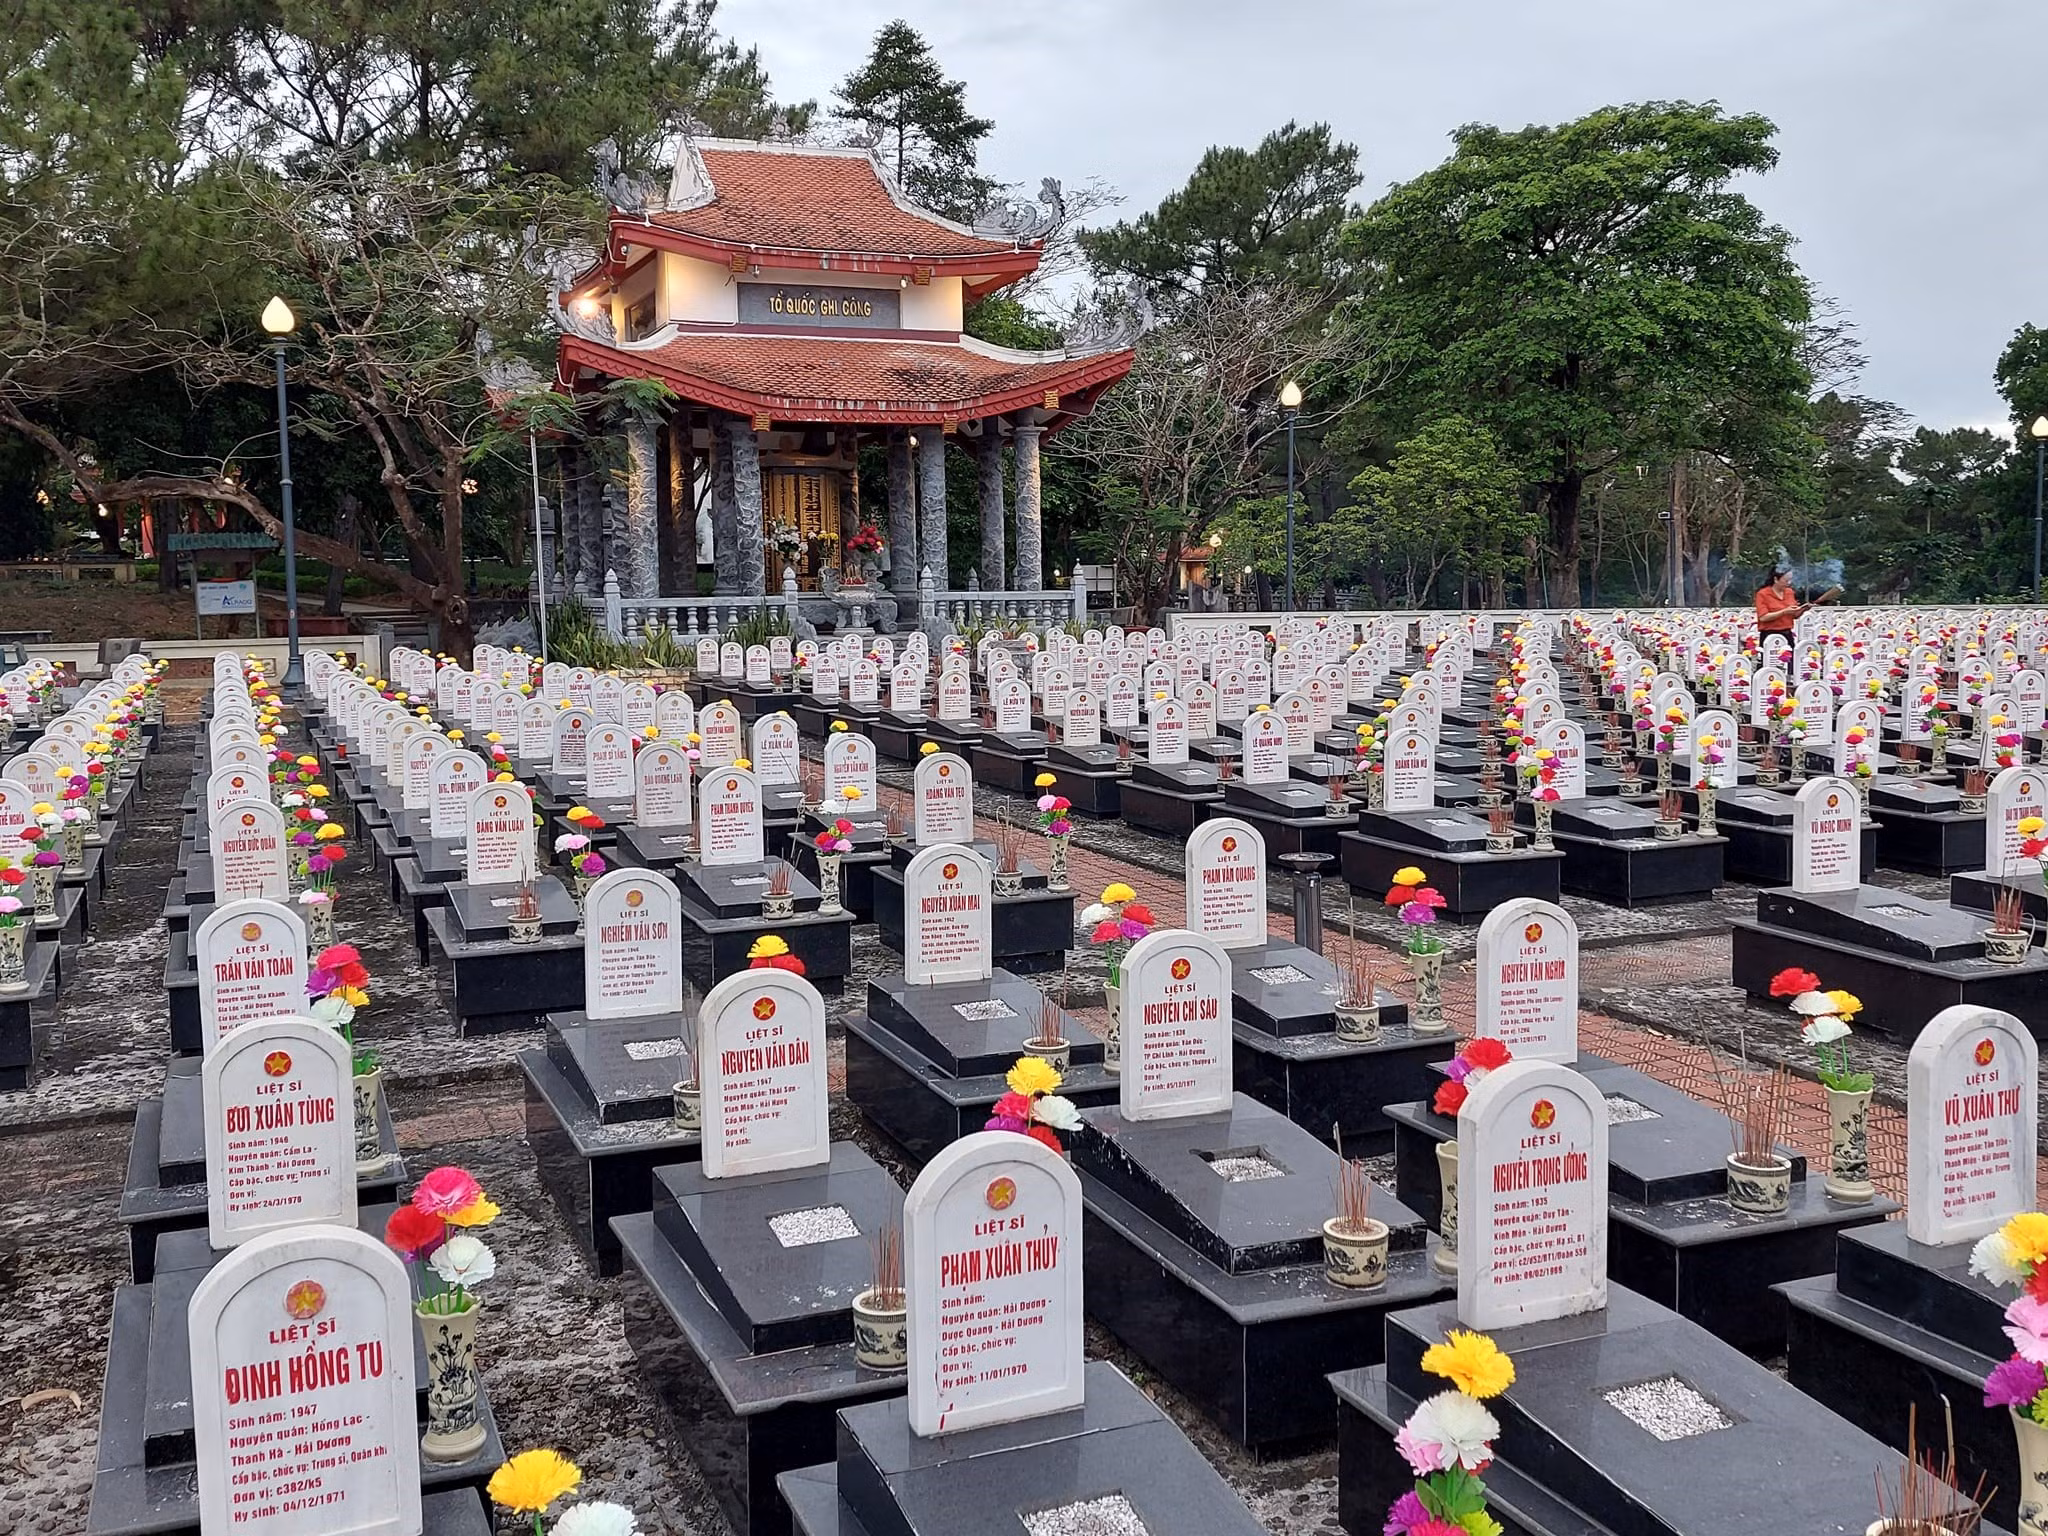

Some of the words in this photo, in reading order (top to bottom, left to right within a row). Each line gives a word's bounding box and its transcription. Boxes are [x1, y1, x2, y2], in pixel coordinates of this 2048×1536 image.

[769, 290, 783, 315] TỔ
[785, 292, 816, 317] QUỐC
[820, 299, 838, 316] GHI
[842, 296, 871, 316] CÔNG
[1164, 983, 1184, 994] LIỆT
[1144, 994, 1180, 1026] NGUYỄN
[1182, 995, 1198, 1022] CHÍ
[1199, 994, 1218, 1020] SÁU
[745, 1028, 769, 1040] LIỆT
[721, 1039, 763, 1076] NGUYỄN
[765, 1040, 786, 1069] VĂN
[788, 1037, 810, 1066] DÂN
[1966, 1072, 1986, 1086] LIỆT
[256, 1082, 284, 1096] LIỆT
[1945, 1093, 1960, 1126] VŨ
[1963, 1088, 1995, 1123] XUÂN
[1521, 1134, 1546, 1149] LIỆT
[1531, 1196, 1548, 1207] 1935
[974, 1219, 1005, 1236] LIỆT
[941, 1248, 981, 1291] PHẠM
[985, 1240, 1022, 1281] XUÂN
[1025, 1223, 1058, 1273] THỦY
[269, 1324, 310, 1345] LIỆT
[291, 1403, 317, 1419] 1947
[276, 1476, 322, 1496] c382/k5
[283, 1490, 345, 1513] 04/12/1971
